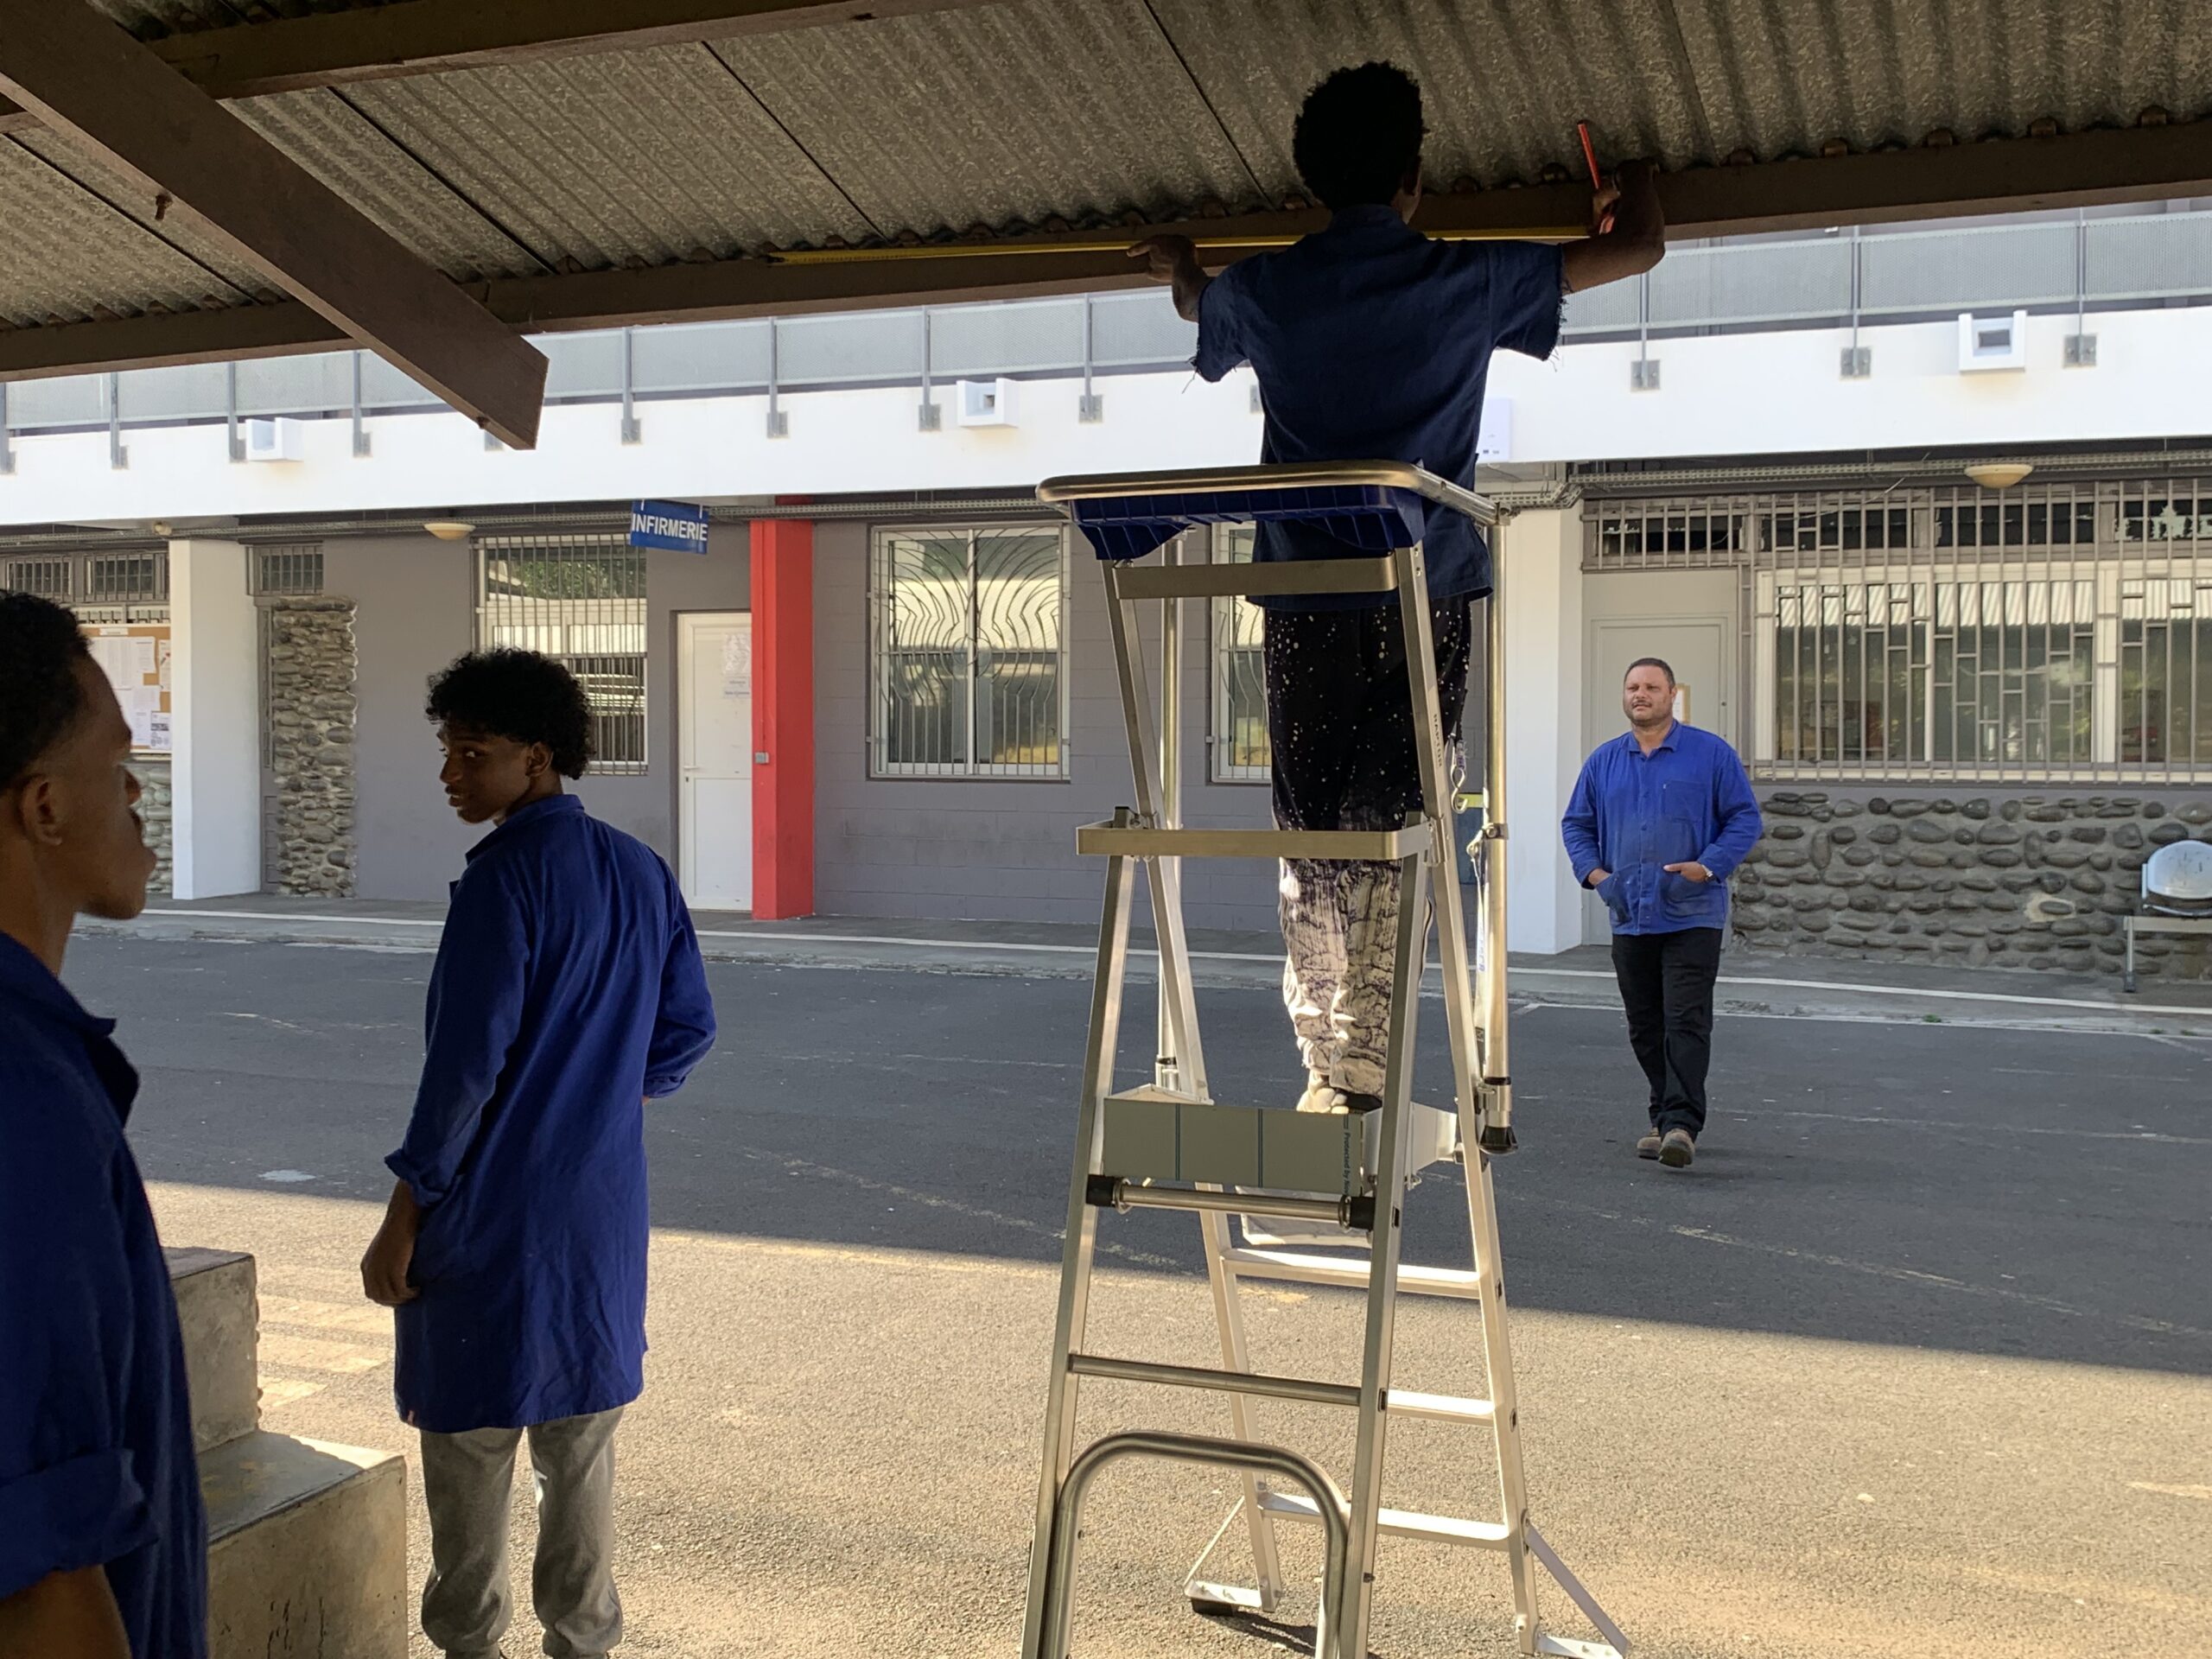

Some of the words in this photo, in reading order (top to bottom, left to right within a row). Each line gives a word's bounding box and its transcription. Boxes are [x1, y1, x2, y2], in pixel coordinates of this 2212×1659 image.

[632, 513, 708, 541] INFIRMERIE
[1433, 713, 1442, 767] RAPTOR
[1343, 1170, 1350, 1179] by
